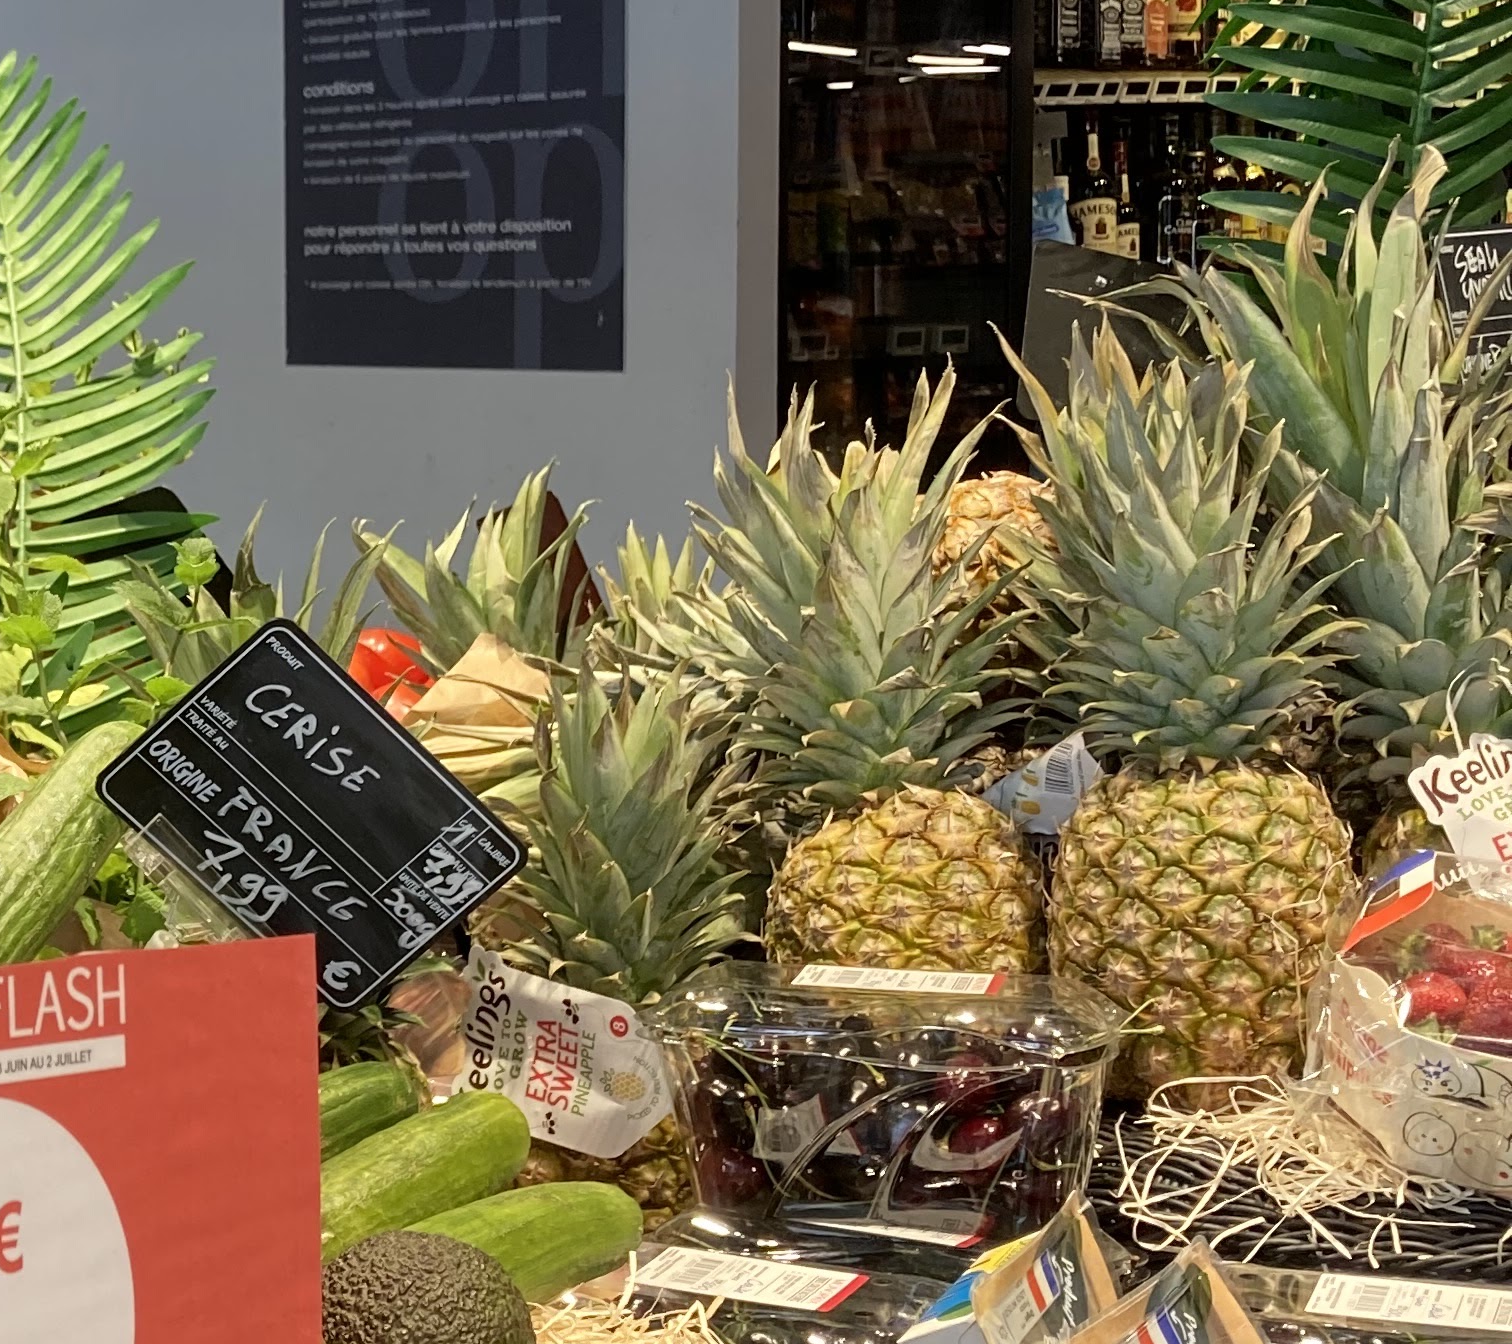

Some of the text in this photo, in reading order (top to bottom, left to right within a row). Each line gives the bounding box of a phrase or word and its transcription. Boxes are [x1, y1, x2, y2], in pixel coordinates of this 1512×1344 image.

[264, 634, 305, 672] PRODUIT
[185, 708, 230, 751] TRAITÉ AU
[199, 695, 238, 730] VARIÉTÉ
[148, 737, 222, 804] ORIGINE
[216, 785, 369, 922] FRANCE
[477, 837, 512, 868] CALIBRE
[321, 959, 362, 992] €
[464, 969, 512, 1091] eelings
[509, 1009, 530, 1080] GROW
[4, 1056, 29, 1075] JUIN
[28, 1055, 46, 1072] AU
[46, 1054, 55, 1070] 2
[54, 1048, 93, 1069] JUILLET
[492, 1044, 511, 1096] OVE
[525, 1019, 558, 1104] EXTRA
[546, 1022, 581, 1112] SWEET
[570, 1030, 597, 1118] PINEAPPLE
